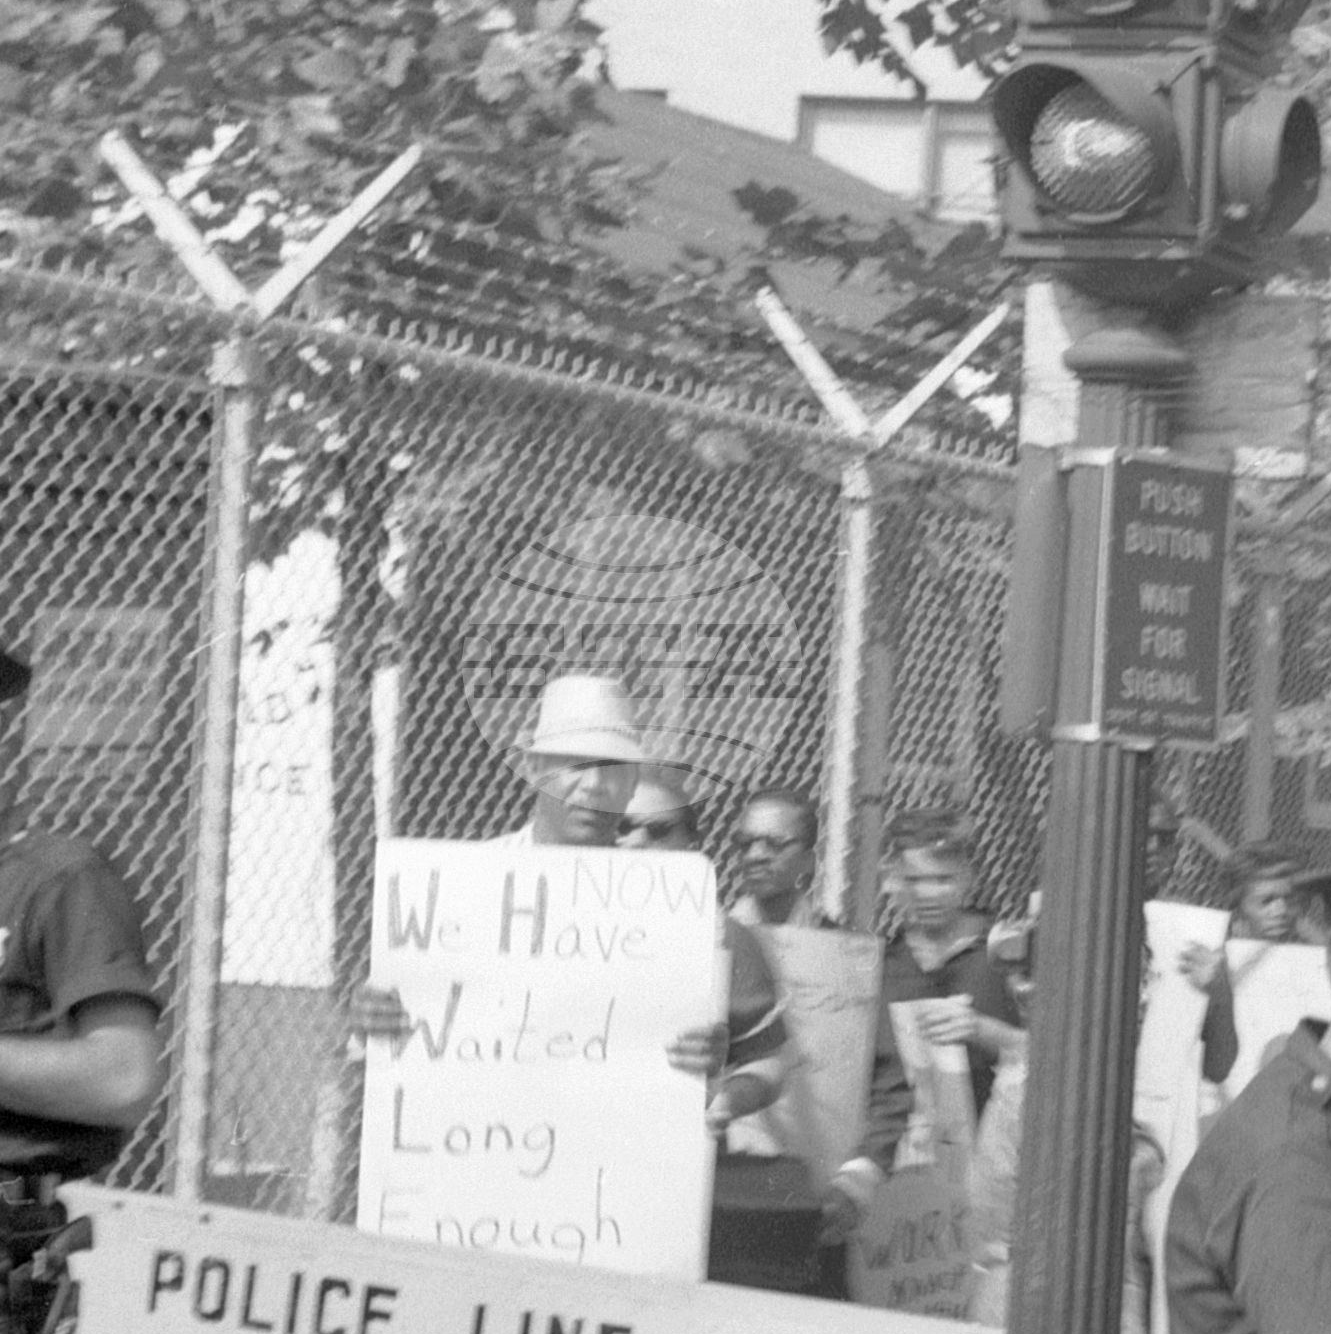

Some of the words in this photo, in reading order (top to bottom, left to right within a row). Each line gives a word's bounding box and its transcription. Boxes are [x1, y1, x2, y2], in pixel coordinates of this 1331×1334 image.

[387, 869, 463, 952] We
[498, 869, 649, 961] Have
[573, 855, 704, 915] NOW
[390, 980, 616, 1063] Waited
[392, 1083, 557, 1178] Long
[379, 1167, 622, 1262] Enough
